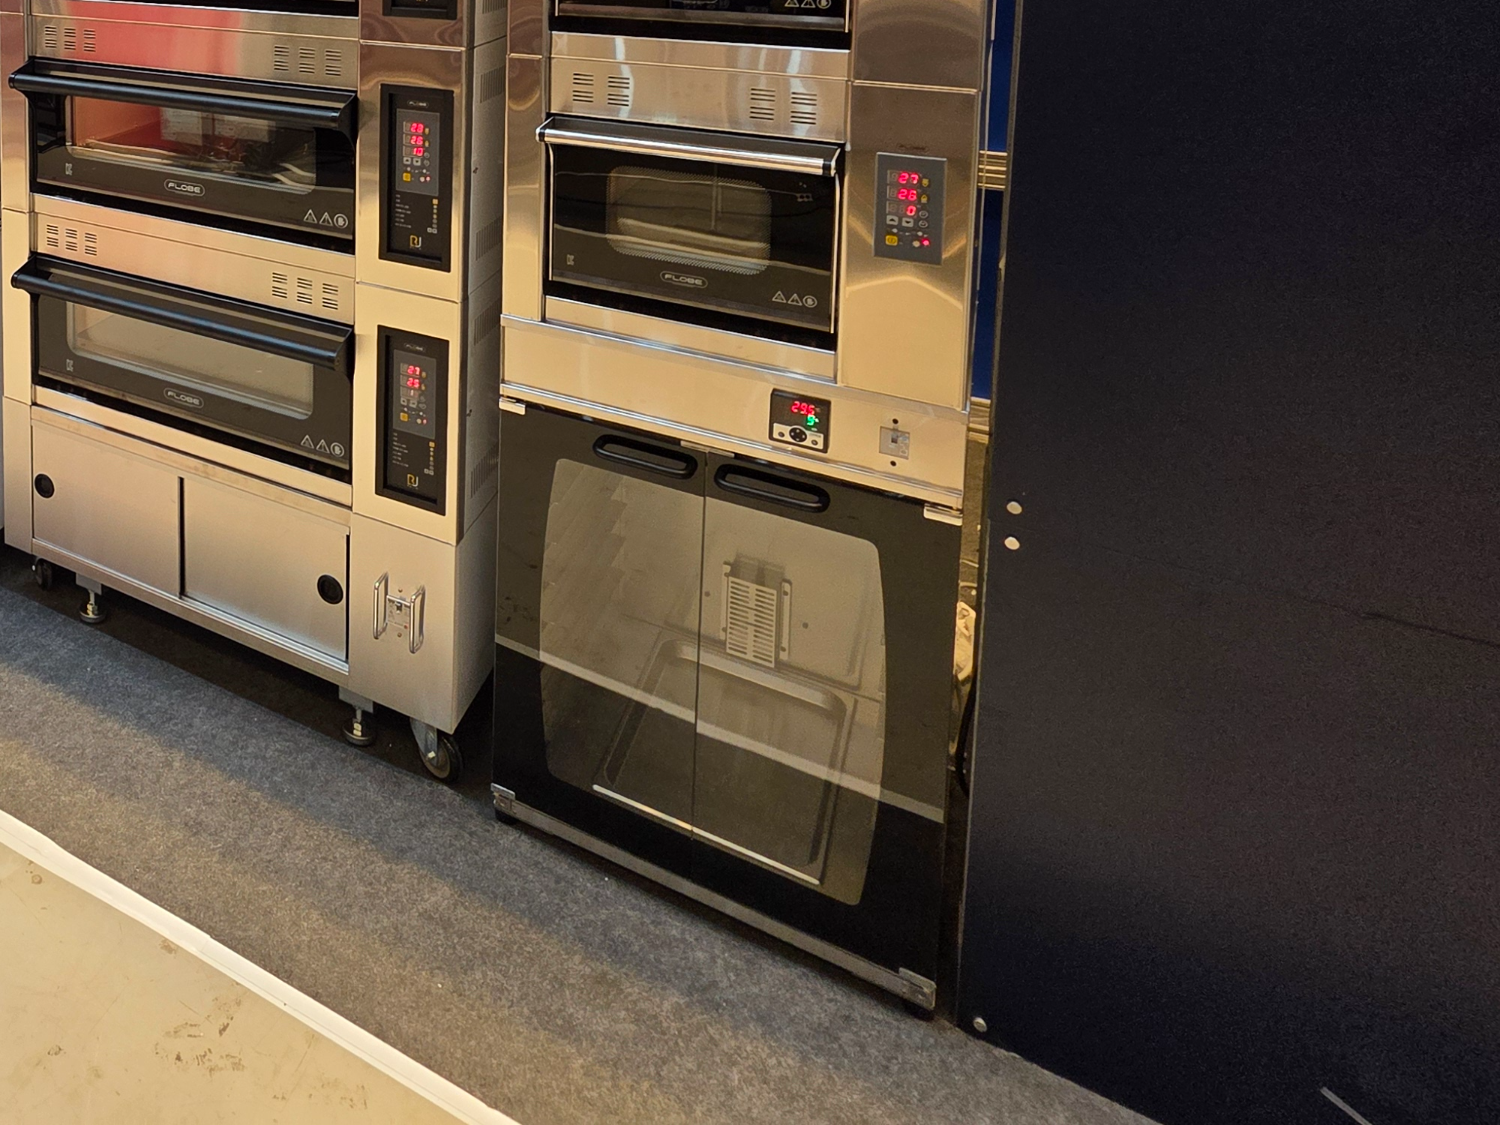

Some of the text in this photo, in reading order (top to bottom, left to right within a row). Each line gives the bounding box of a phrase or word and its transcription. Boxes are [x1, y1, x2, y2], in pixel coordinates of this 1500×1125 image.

[168, 182, 201, 193] FLOBE
[898, 188, 917, 201] 26
[665, 274, 703, 285] FLOBE
